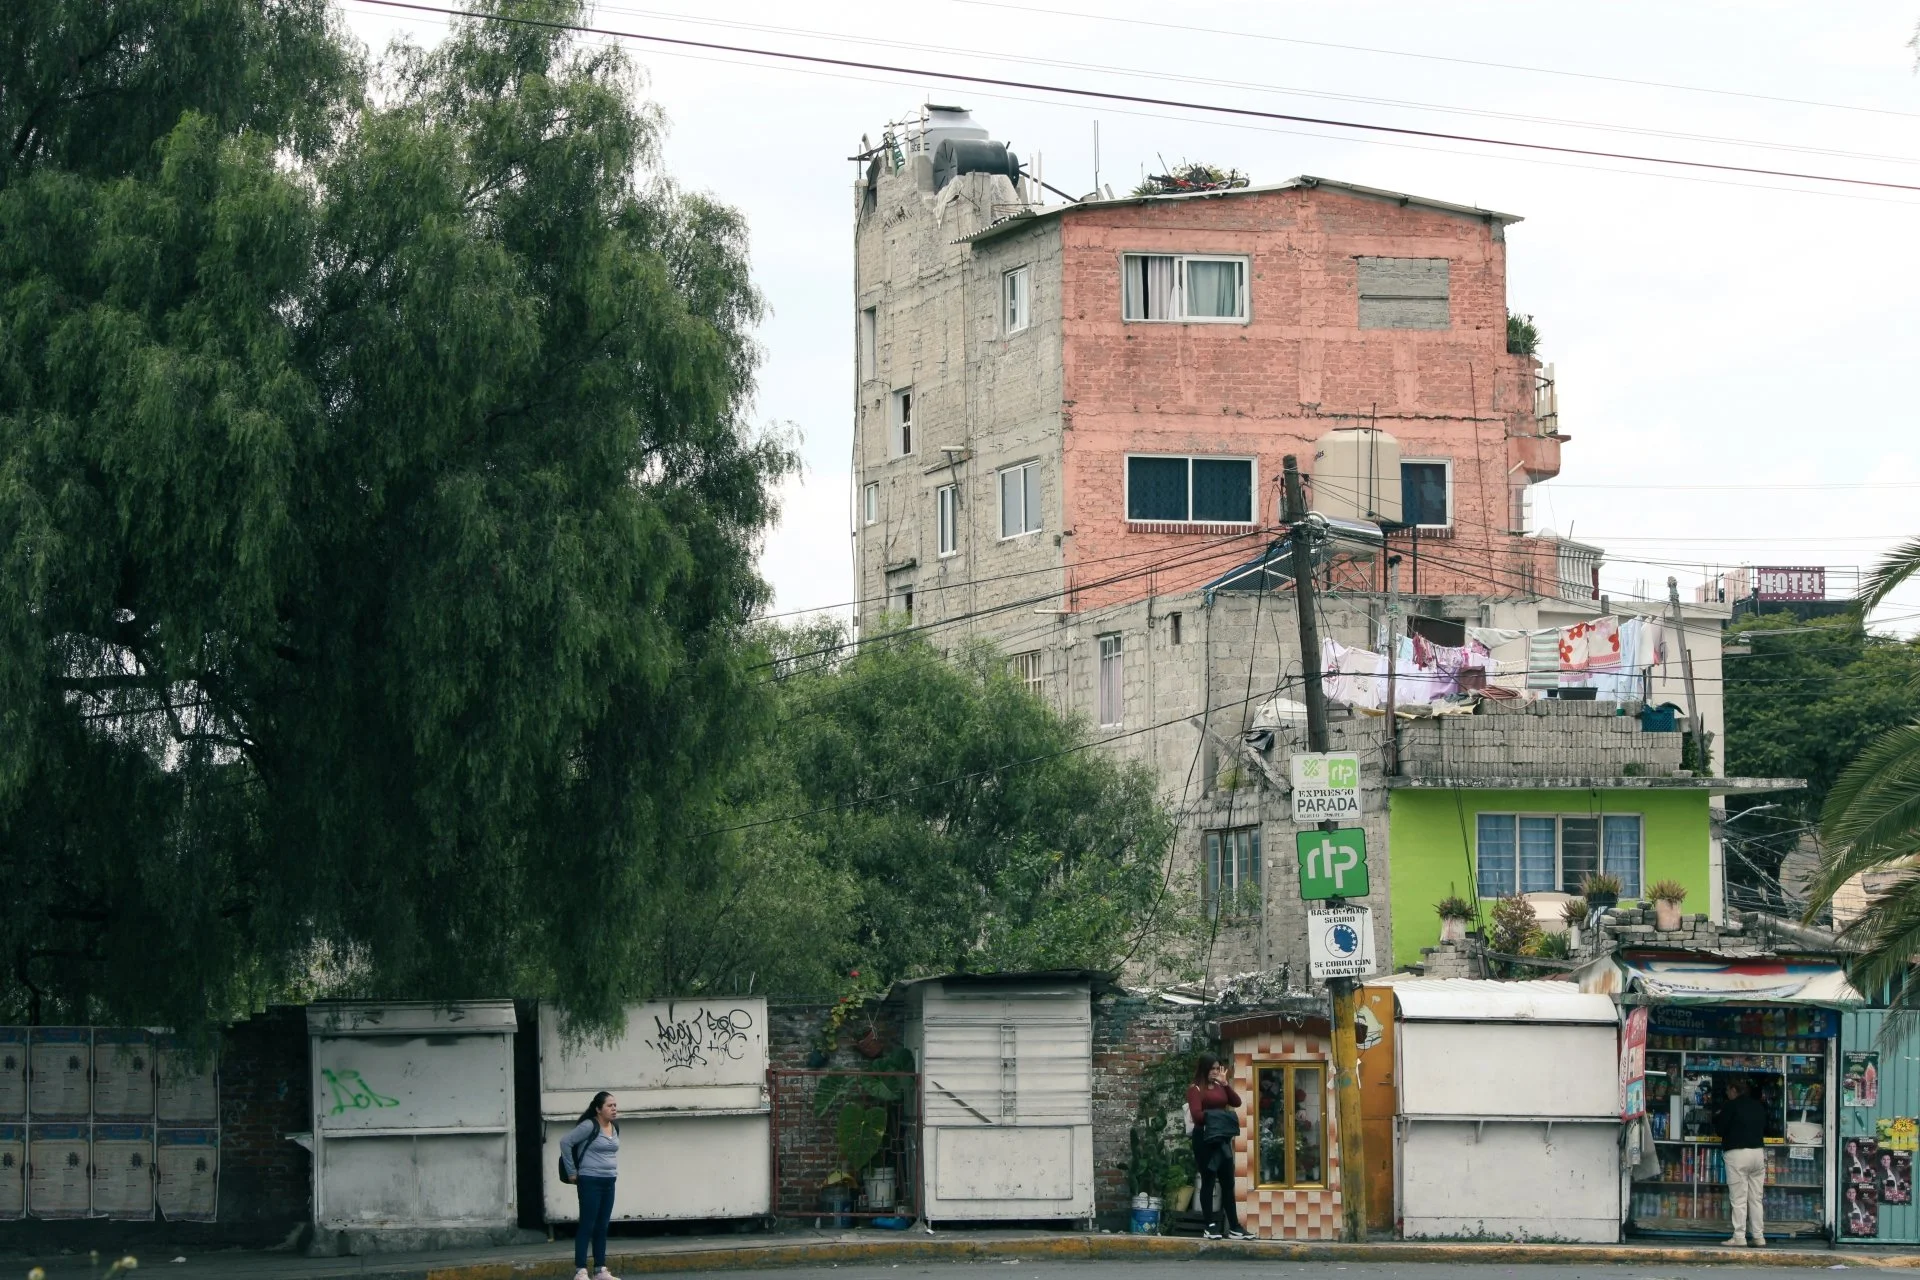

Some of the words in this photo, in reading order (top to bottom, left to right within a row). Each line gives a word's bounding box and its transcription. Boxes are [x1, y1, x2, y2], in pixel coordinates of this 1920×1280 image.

[1760, 573, 1822, 594] HOTEL
[1331, 764, 1354, 785] rtp
[1297, 797, 1358, 813] PARADA
[1307, 839, 1358, 889] rtp
[1325, 916, 1356, 924] SEGURO
[1657, 1005, 1693, 1018] Grupo
